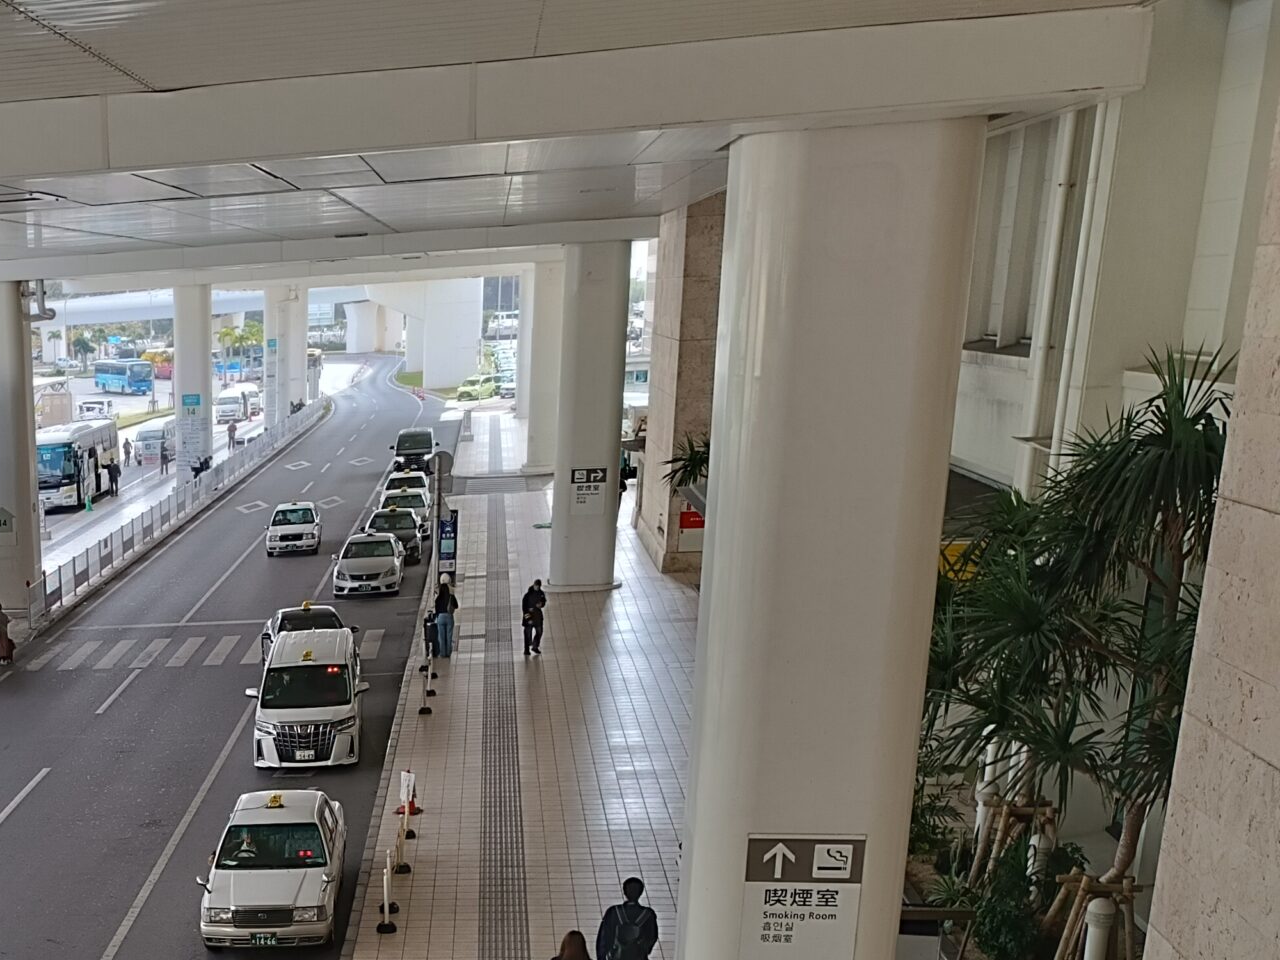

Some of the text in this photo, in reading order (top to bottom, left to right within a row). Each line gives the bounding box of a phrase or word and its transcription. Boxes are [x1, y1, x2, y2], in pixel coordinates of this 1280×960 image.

[763, 888, 839, 907] 喫煙室
[763, 910, 837, 921] Smoking Room
